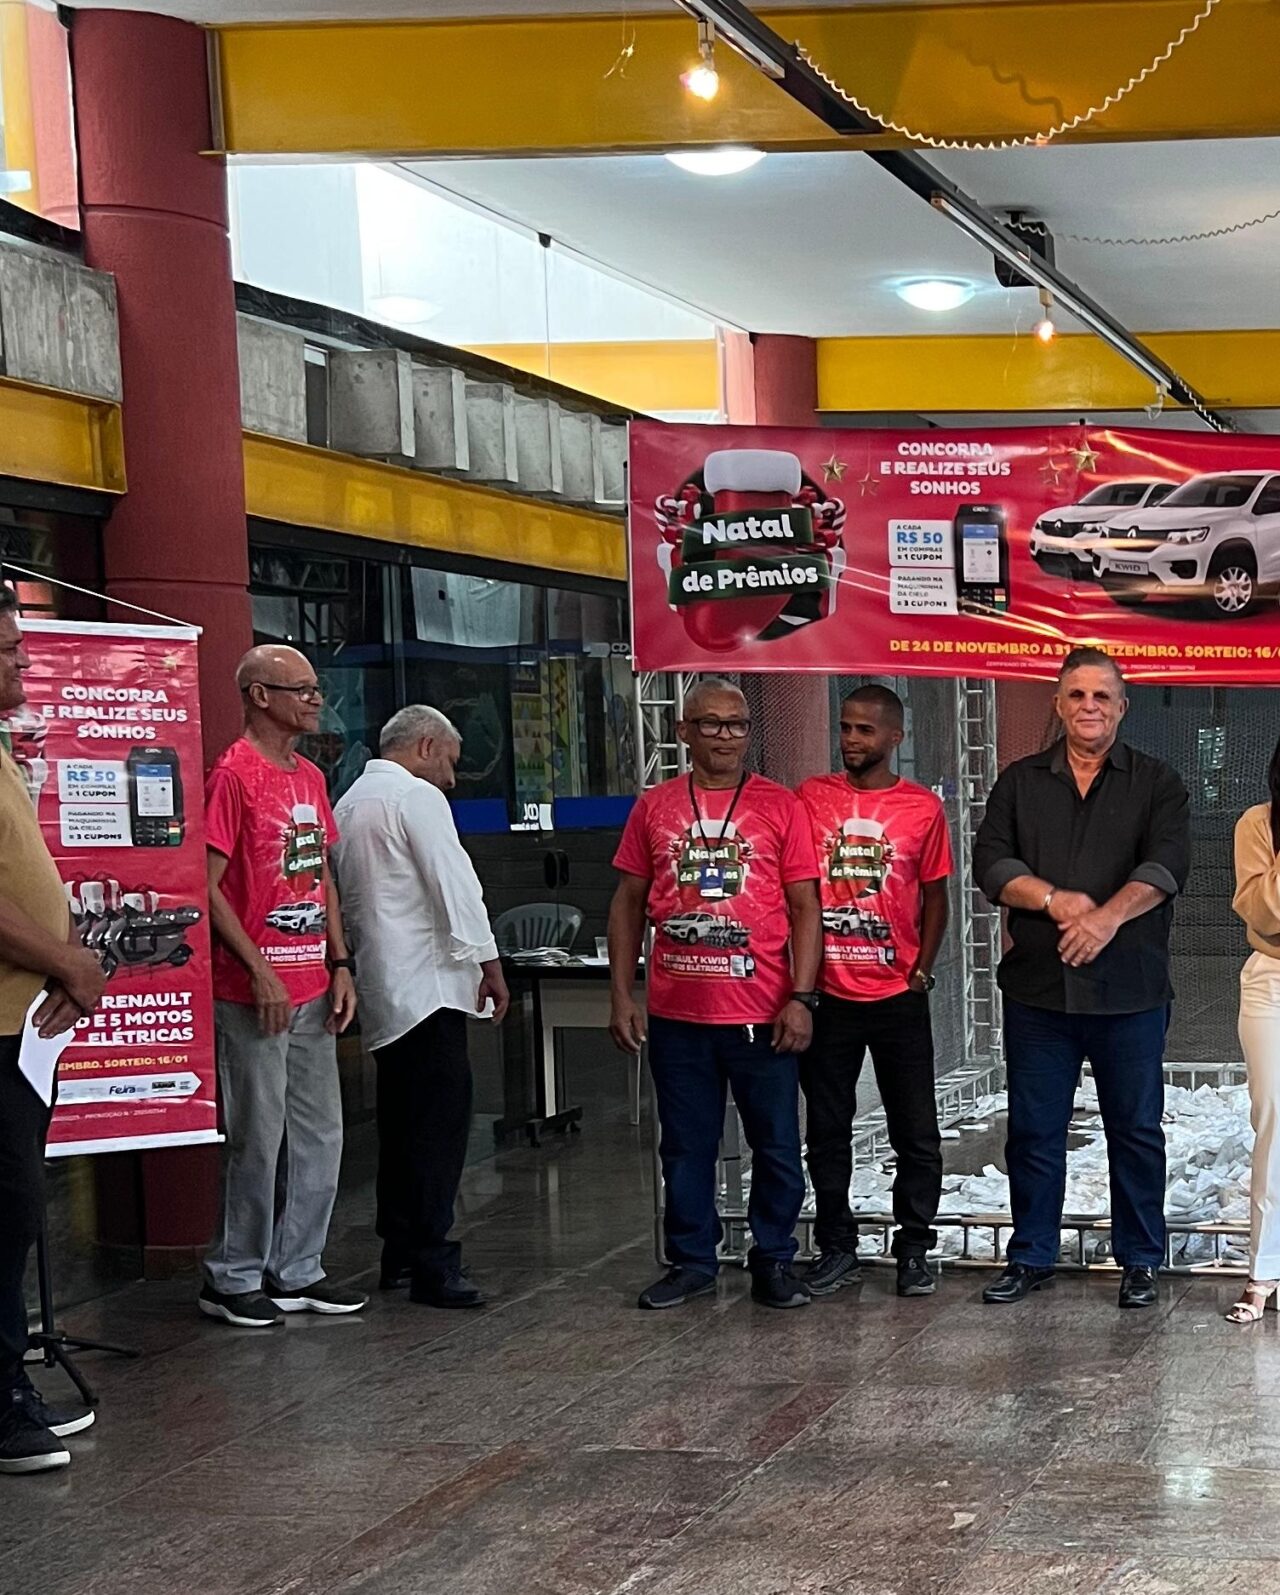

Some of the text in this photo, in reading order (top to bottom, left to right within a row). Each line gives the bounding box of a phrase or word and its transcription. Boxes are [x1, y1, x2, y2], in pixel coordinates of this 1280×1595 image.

[898, 442, 993, 456] CONCORRA
[880, 461, 1011, 476] E REALIZE SEUS
[910, 481, 981, 495] SONHOS
[702, 514, 794, 545] Natal
[923, 532, 943, 544] 50
[1114, 563, 1141, 571] KWID
[682, 562, 819, 593] de Prêmios
[890, 639, 1071, 656] DE 24 DE NOVEMBRO A 31
[1184, 645, 1252, 659] SORTEIO:
[61, 686, 168, 703] CONCORRA
[42, 705, 188, 722] E REALIZE SEUS
[77, 725, 156, 739] SONHOS
[94, 771, 116, 782] 50
[689, 847, 729, 860] Naal
[839, 846, 875, 857] Natal
[700, 955, 729, 965] KWID
[686, 964, 730, 973] ELÉTRICAS
[101, 992, 192, 1010] RENAULT
[94, 1014, 107, 1027] E
[110, 1013, 122, 1027] 5
[125, 1010, 193, 1026] MOTOS
[88, 1027, 194, 1045] ELÉTRICAS
[104, 1057, 156, 1069] SORTEIO:
[158, 1055, 188, 1065] 16/01
[109, 1085, 136, 1095] Feira
